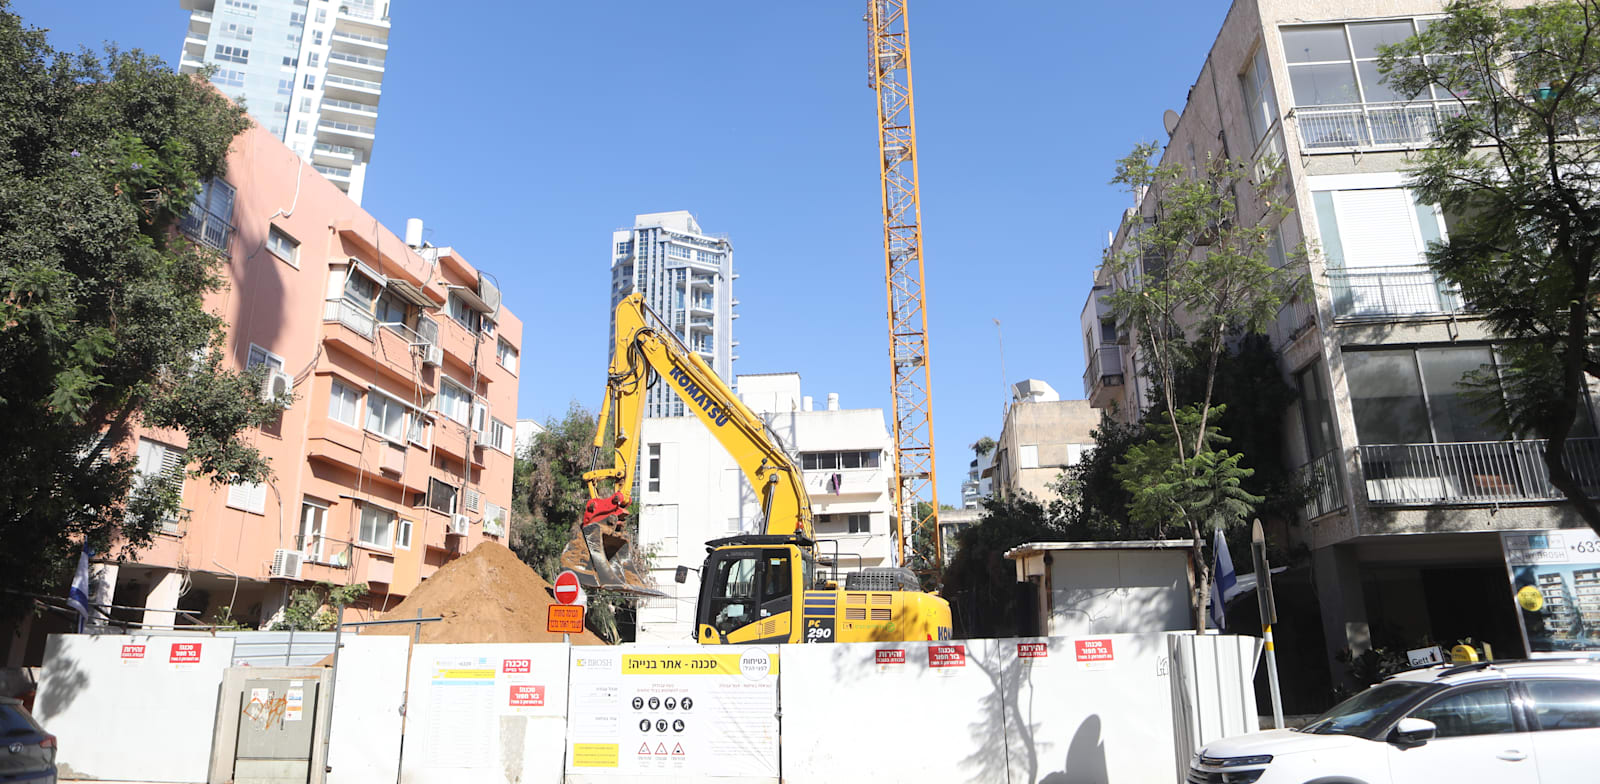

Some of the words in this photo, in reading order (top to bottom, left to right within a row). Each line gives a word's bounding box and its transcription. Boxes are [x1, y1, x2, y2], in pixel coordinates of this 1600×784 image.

[669, 365, 729, 427] KOMATSU
[807, 628, 831, 638] 290
[628, 659, 657, 669] בנייה!
[660, 660, 681, 669] אתר
[691, 660, 717, 669] סכנה
[1412, 656, 1429, 665] Gett
